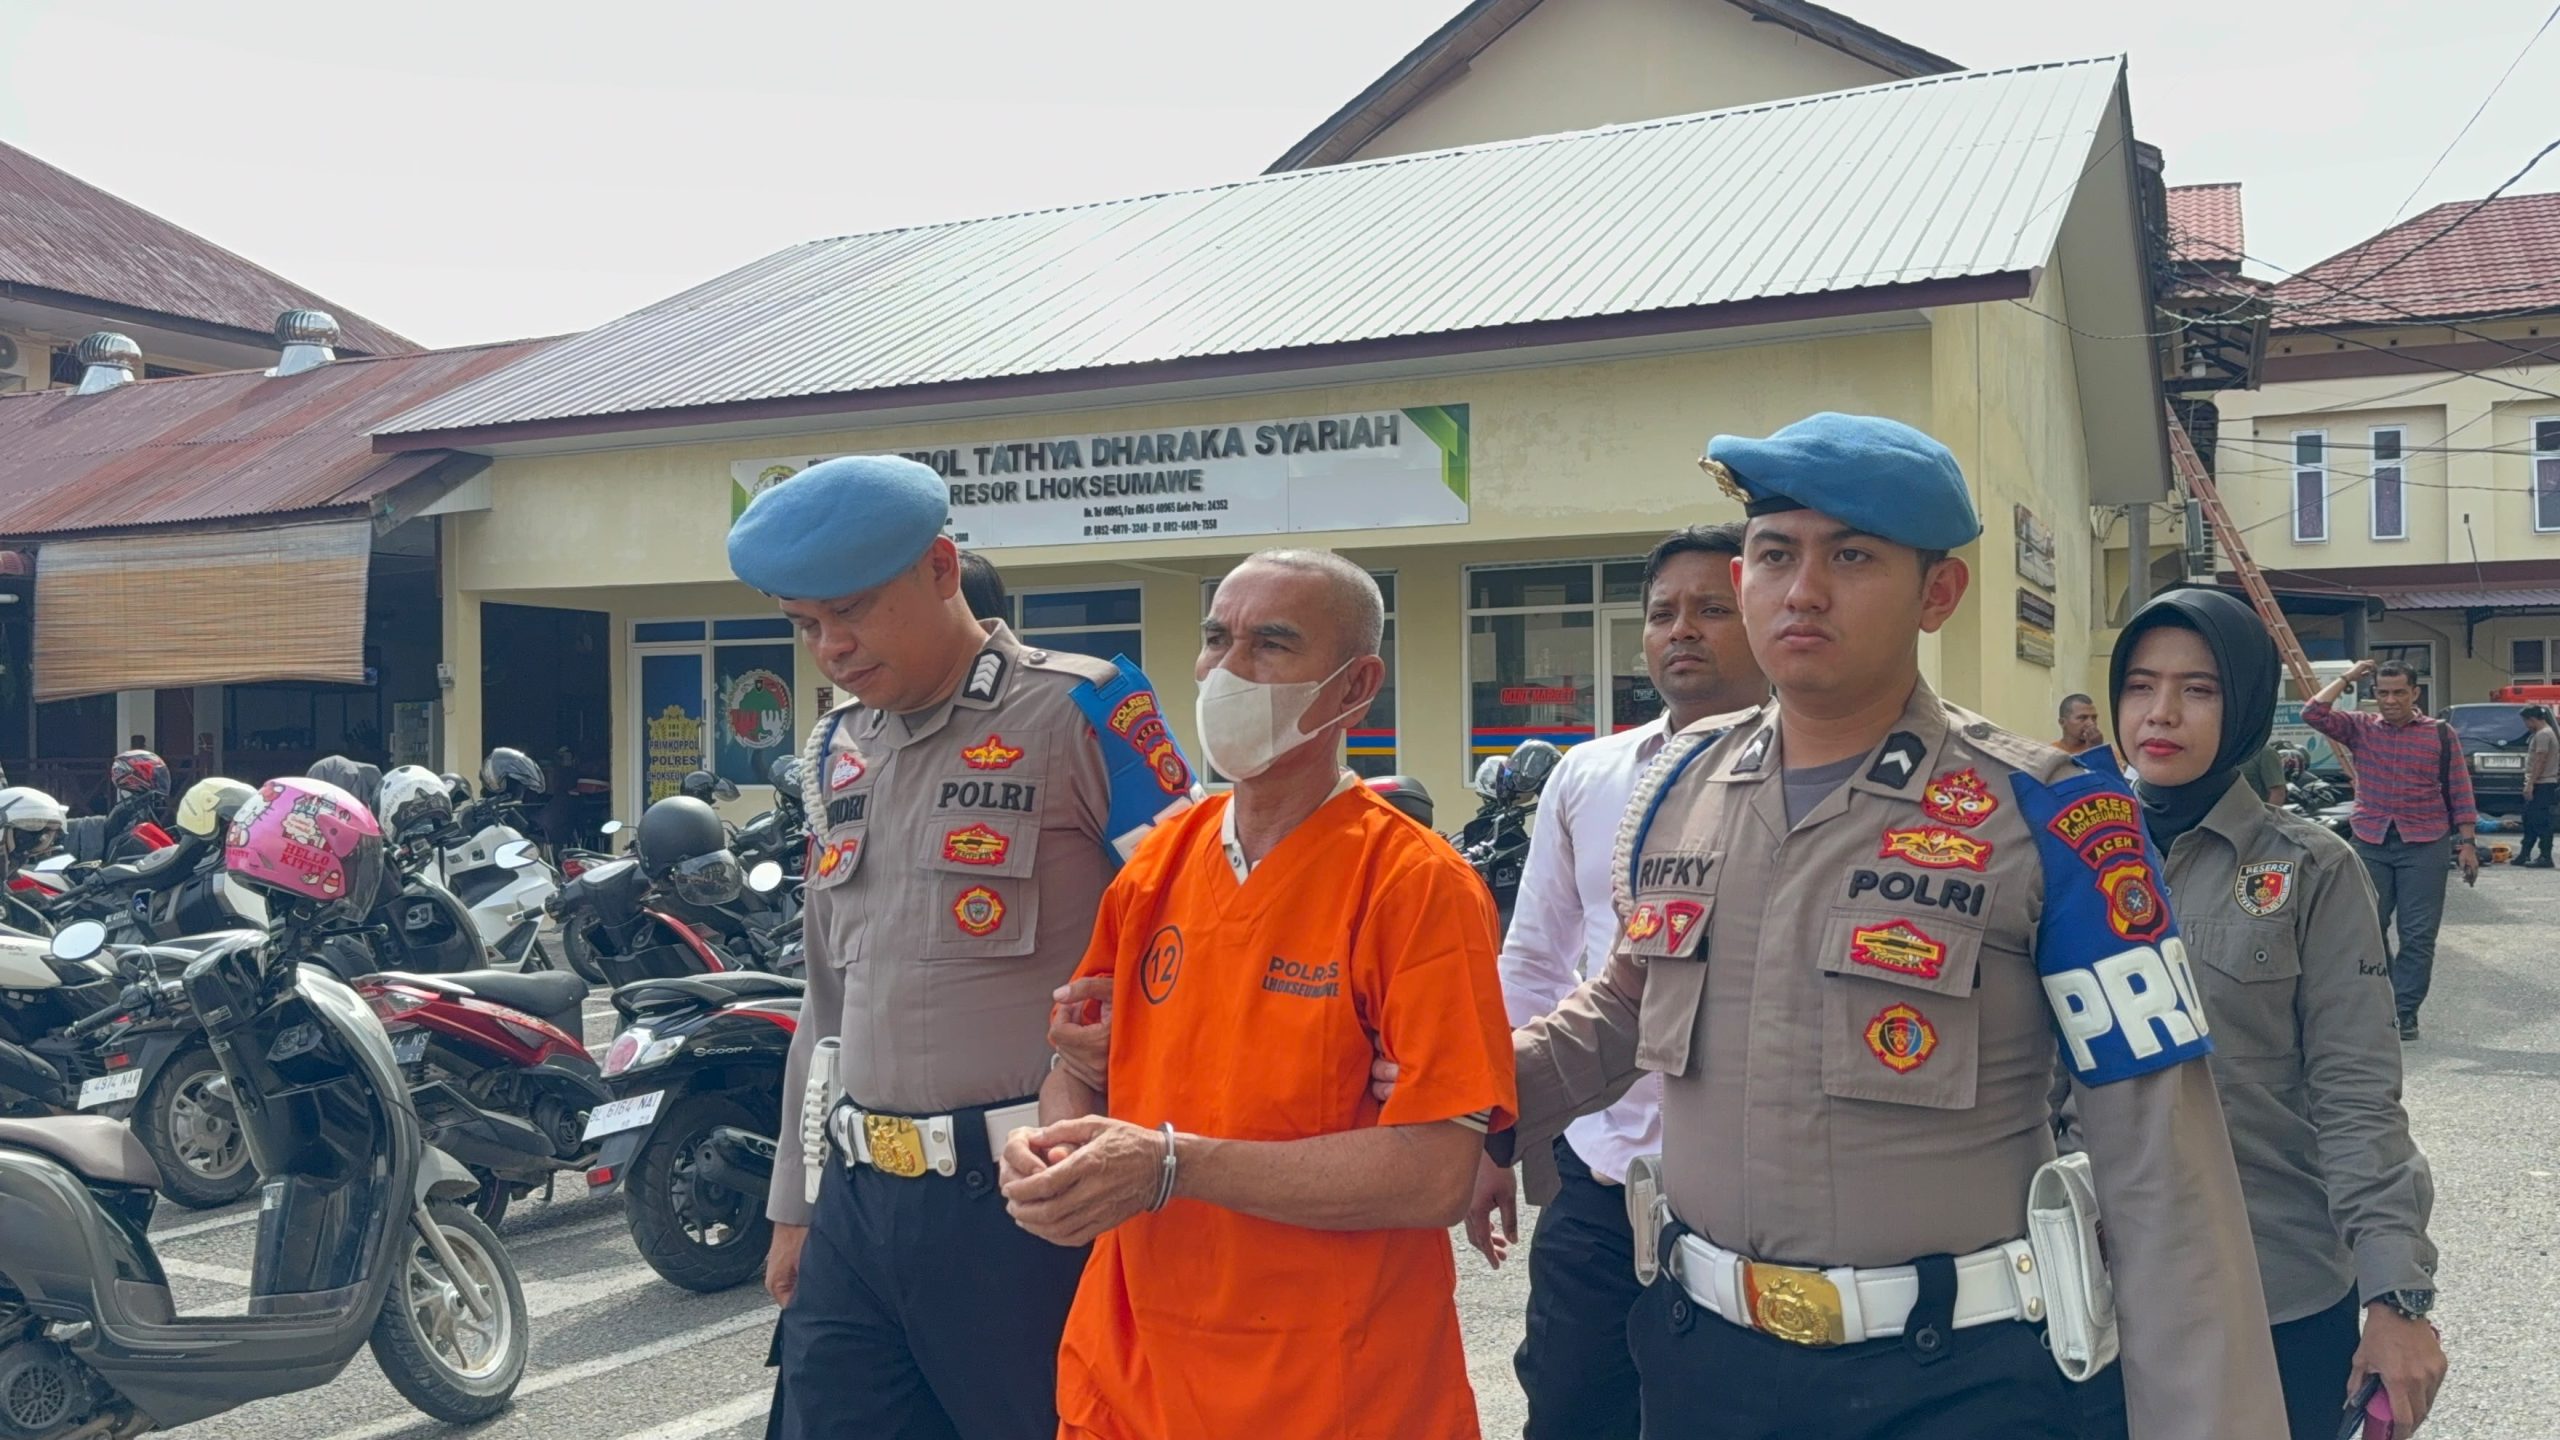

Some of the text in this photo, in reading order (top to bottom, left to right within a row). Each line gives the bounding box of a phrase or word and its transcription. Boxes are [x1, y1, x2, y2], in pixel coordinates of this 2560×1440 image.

[973, 440, 1085, 475] TATHYA
[1091, 427, 1248, 467] DHARAKA
[1255, 414, 1399, 455] SYARIAH
[950, 469, 1203, 505] RESOR LHOKSEUMAWE
[1112, 695, 1151, 728] POLRES
[648, 739, 699, 750] PRIMKOPPOL
[652, 755, 698, 766] POLRES
[938, 781, 1036, 812] POLRI
[2057, 798, 2132, 833] POLRES
[285, 843, 330, 866] HELLO
[2094, 837, 2133, 859] ACEH
[280, 855, 326, 875] KITTY
[1640, 856, 1715, 888] RIFKY
[2246, 863, 2290, 874] RESERSE
[1848, 869, 1986, 917] POLRI
[1150, 945, 1177, 984] 12
[1269, 956, 1339, 981] POLRS
